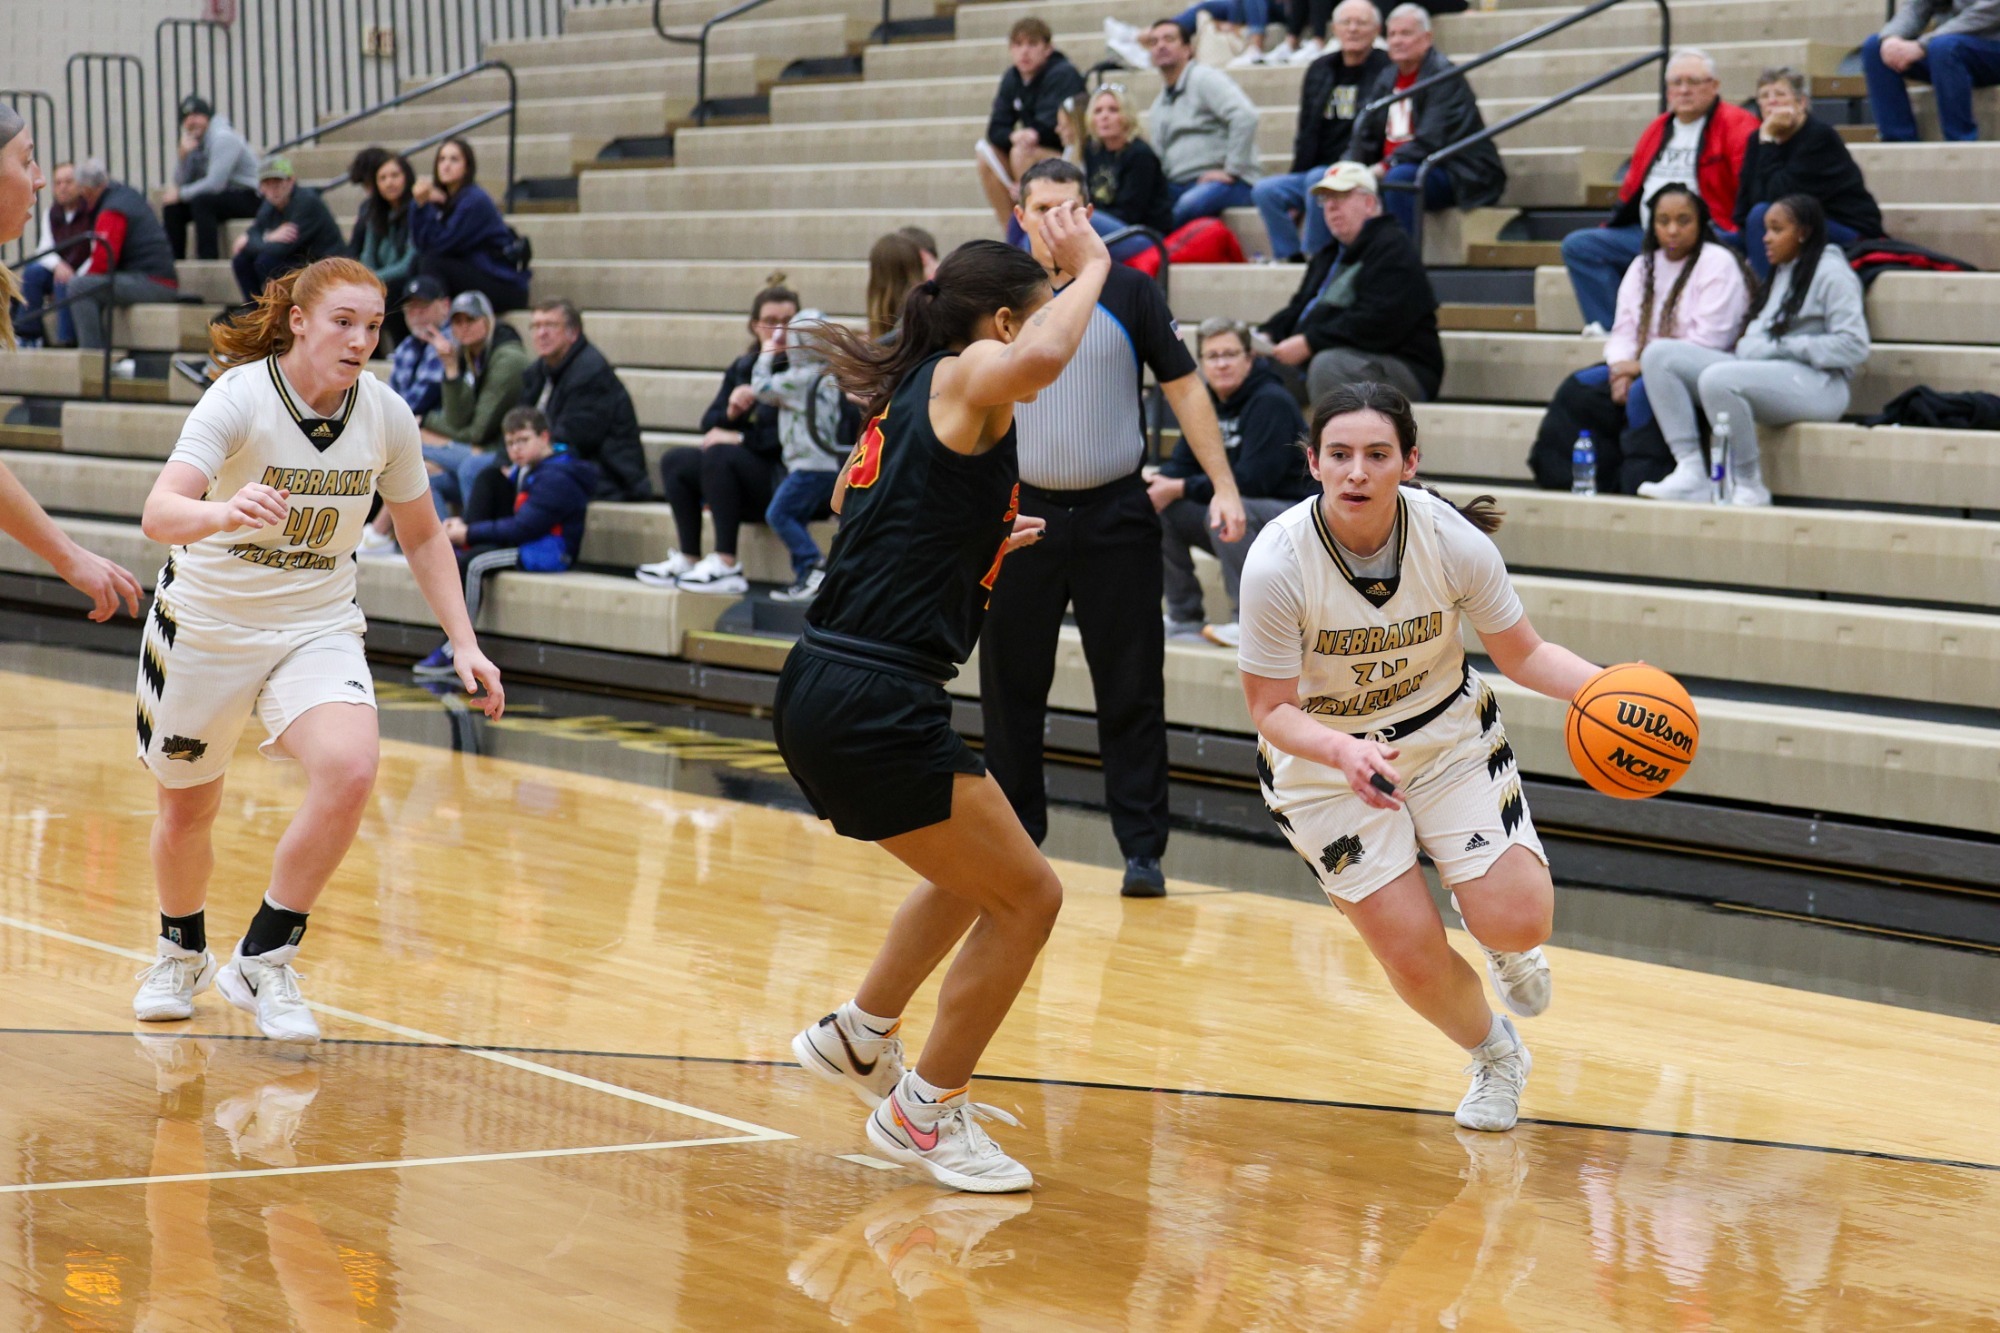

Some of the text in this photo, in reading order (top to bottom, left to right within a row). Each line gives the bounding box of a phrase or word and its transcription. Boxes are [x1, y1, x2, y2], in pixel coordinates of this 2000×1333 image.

[260, 465, 373, 496] NEBRASKA
[283, 507, 339, 549] 40
[1365, 588, 1391, 596] adidas
[1313, 611, 1443, 656] NEBRASKA
[1616, 700, 1693, 756] Wilson
[1607, 746, 1671, 783] NCAA
[1464, 840, 1490, 852] adidas
